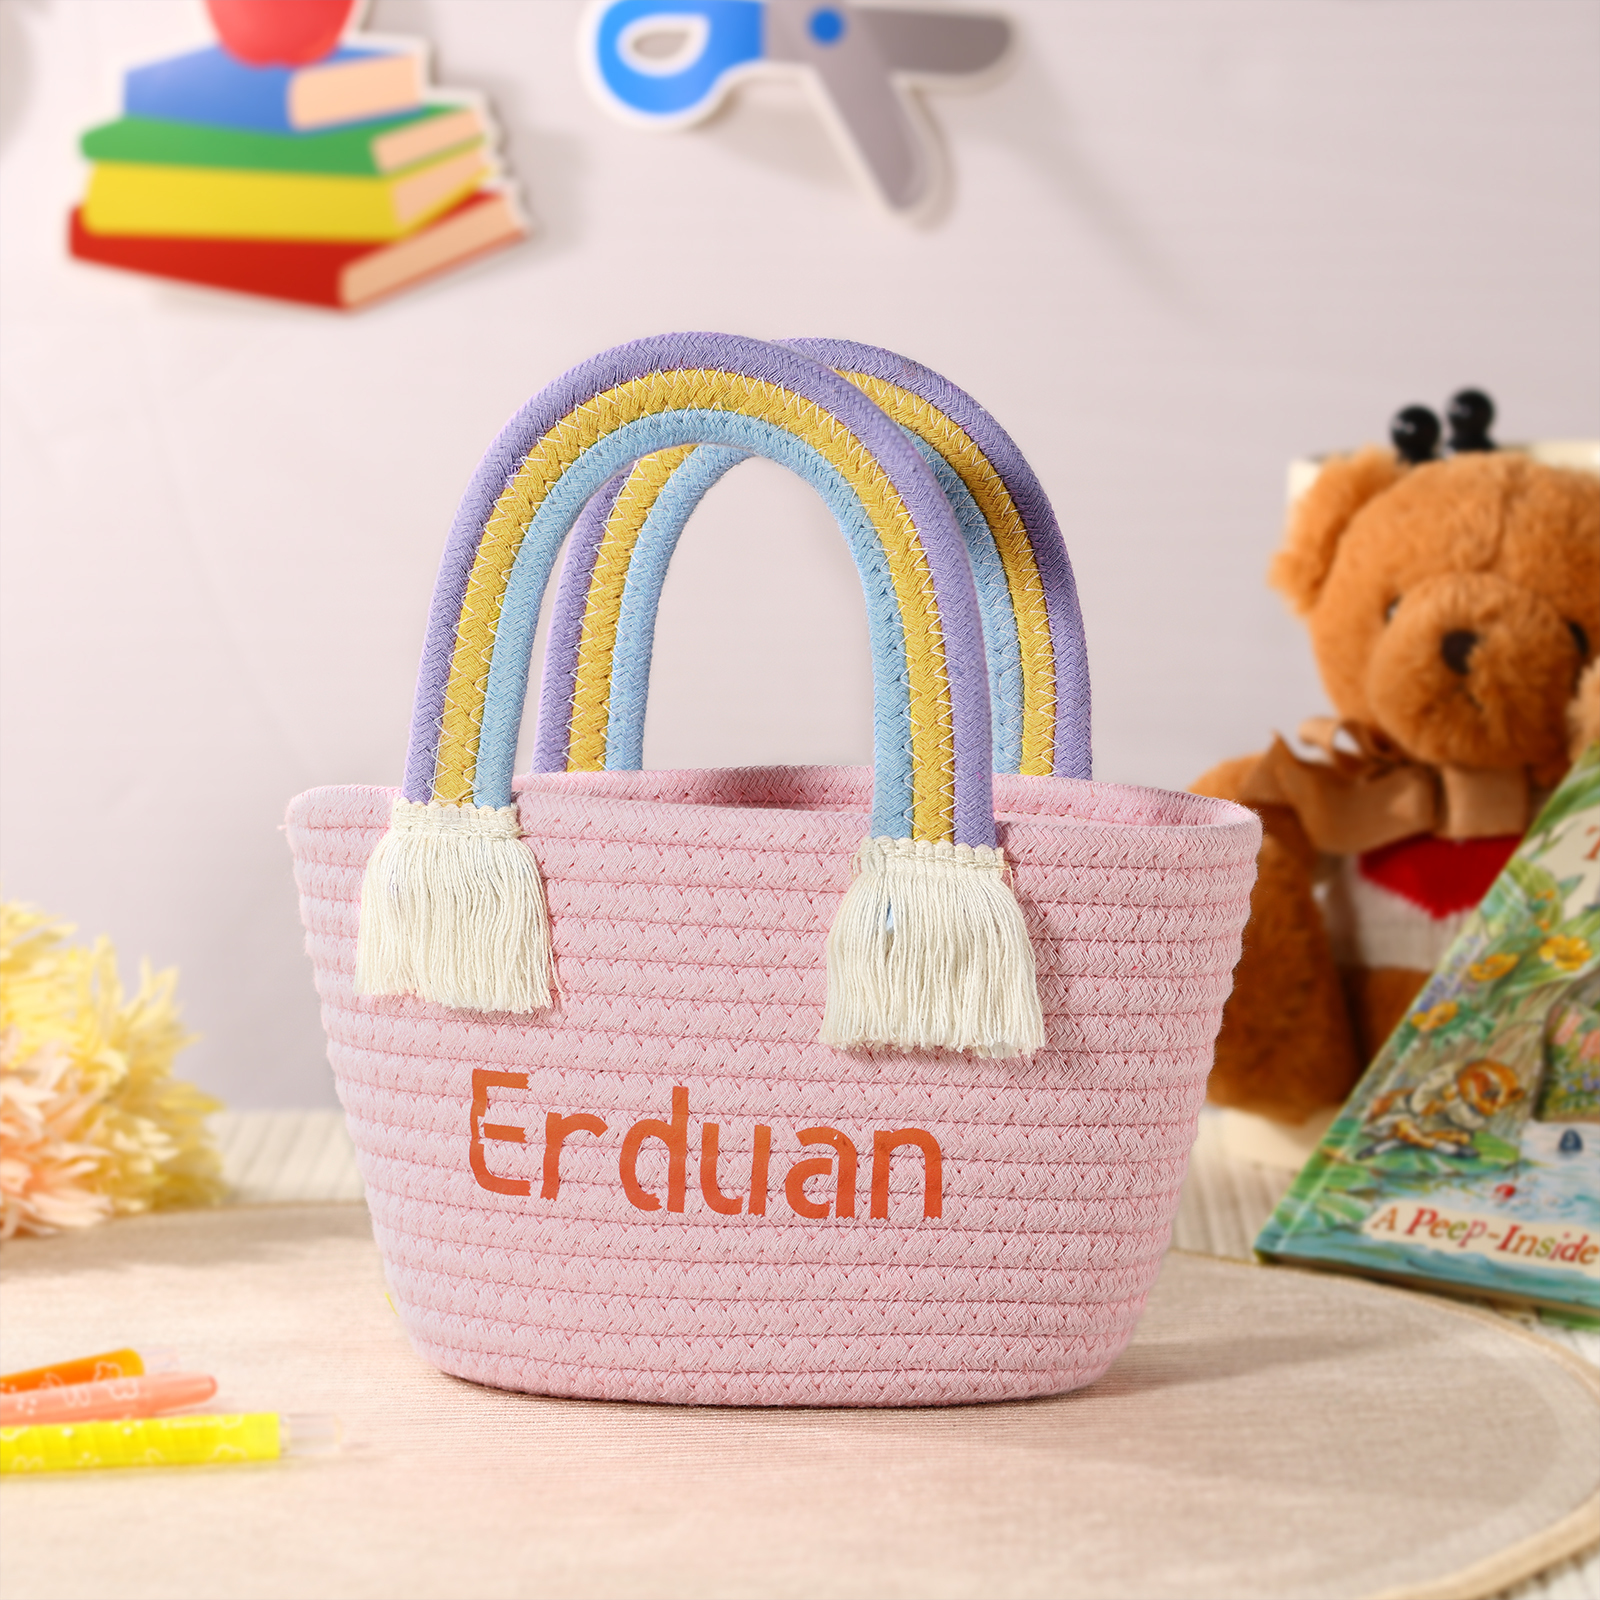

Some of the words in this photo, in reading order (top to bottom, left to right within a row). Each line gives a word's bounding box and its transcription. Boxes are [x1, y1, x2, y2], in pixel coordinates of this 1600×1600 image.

[469, 1069, 943, 1220] Erduan
[1372, 1206, 1399, 1232] A
[1405, 1207, 1600, 1264] Peep-Inside
